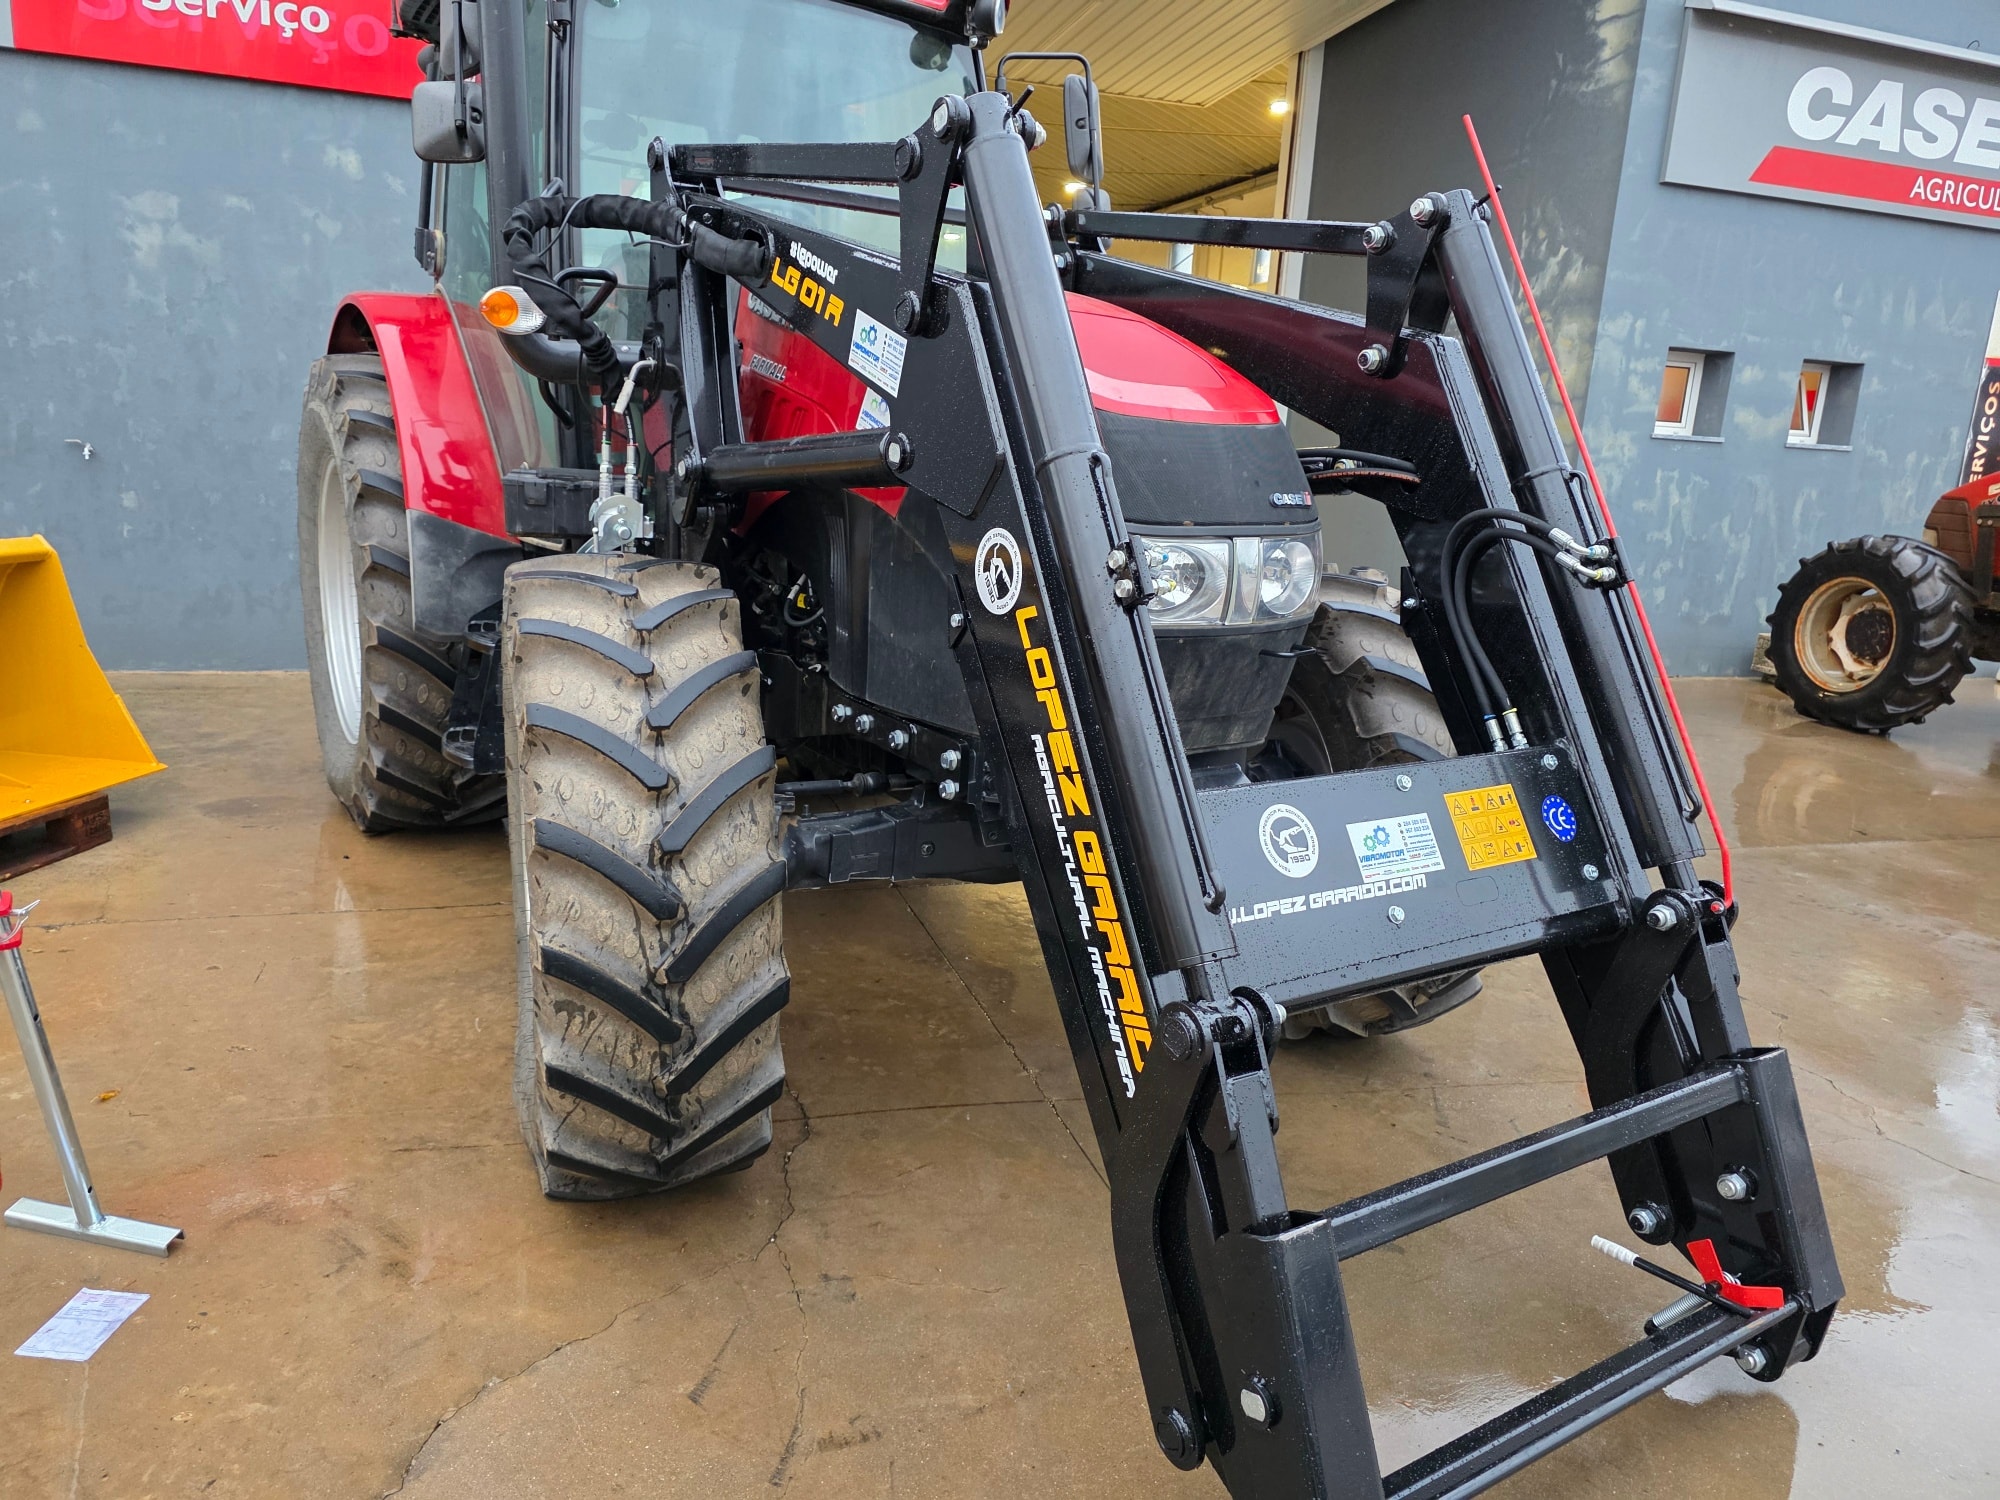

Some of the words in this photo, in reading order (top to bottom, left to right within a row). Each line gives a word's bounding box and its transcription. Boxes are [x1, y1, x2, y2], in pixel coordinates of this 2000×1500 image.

[1787, 66, 2000, 170] CASE
[771, 256, 801, 296] LG
[800, 279, 826, 315] 01
[824, 293, 845, 327] R
[750, 354, 787, 382] FARMALL
[1273, 492, 1303, 506] CASE
[1015, 605, 1092, 817] LOPEZ
[1549, 806, 1571, 831] CE
[1031, 734, 1091, 940] AGRICULTURAL
[1289, 854, 1311, 864] 1930
[1358, 849, 1405, 864] VIBROMOTOR
[1308, 873, 1427, 909] GARRIDO.COM
